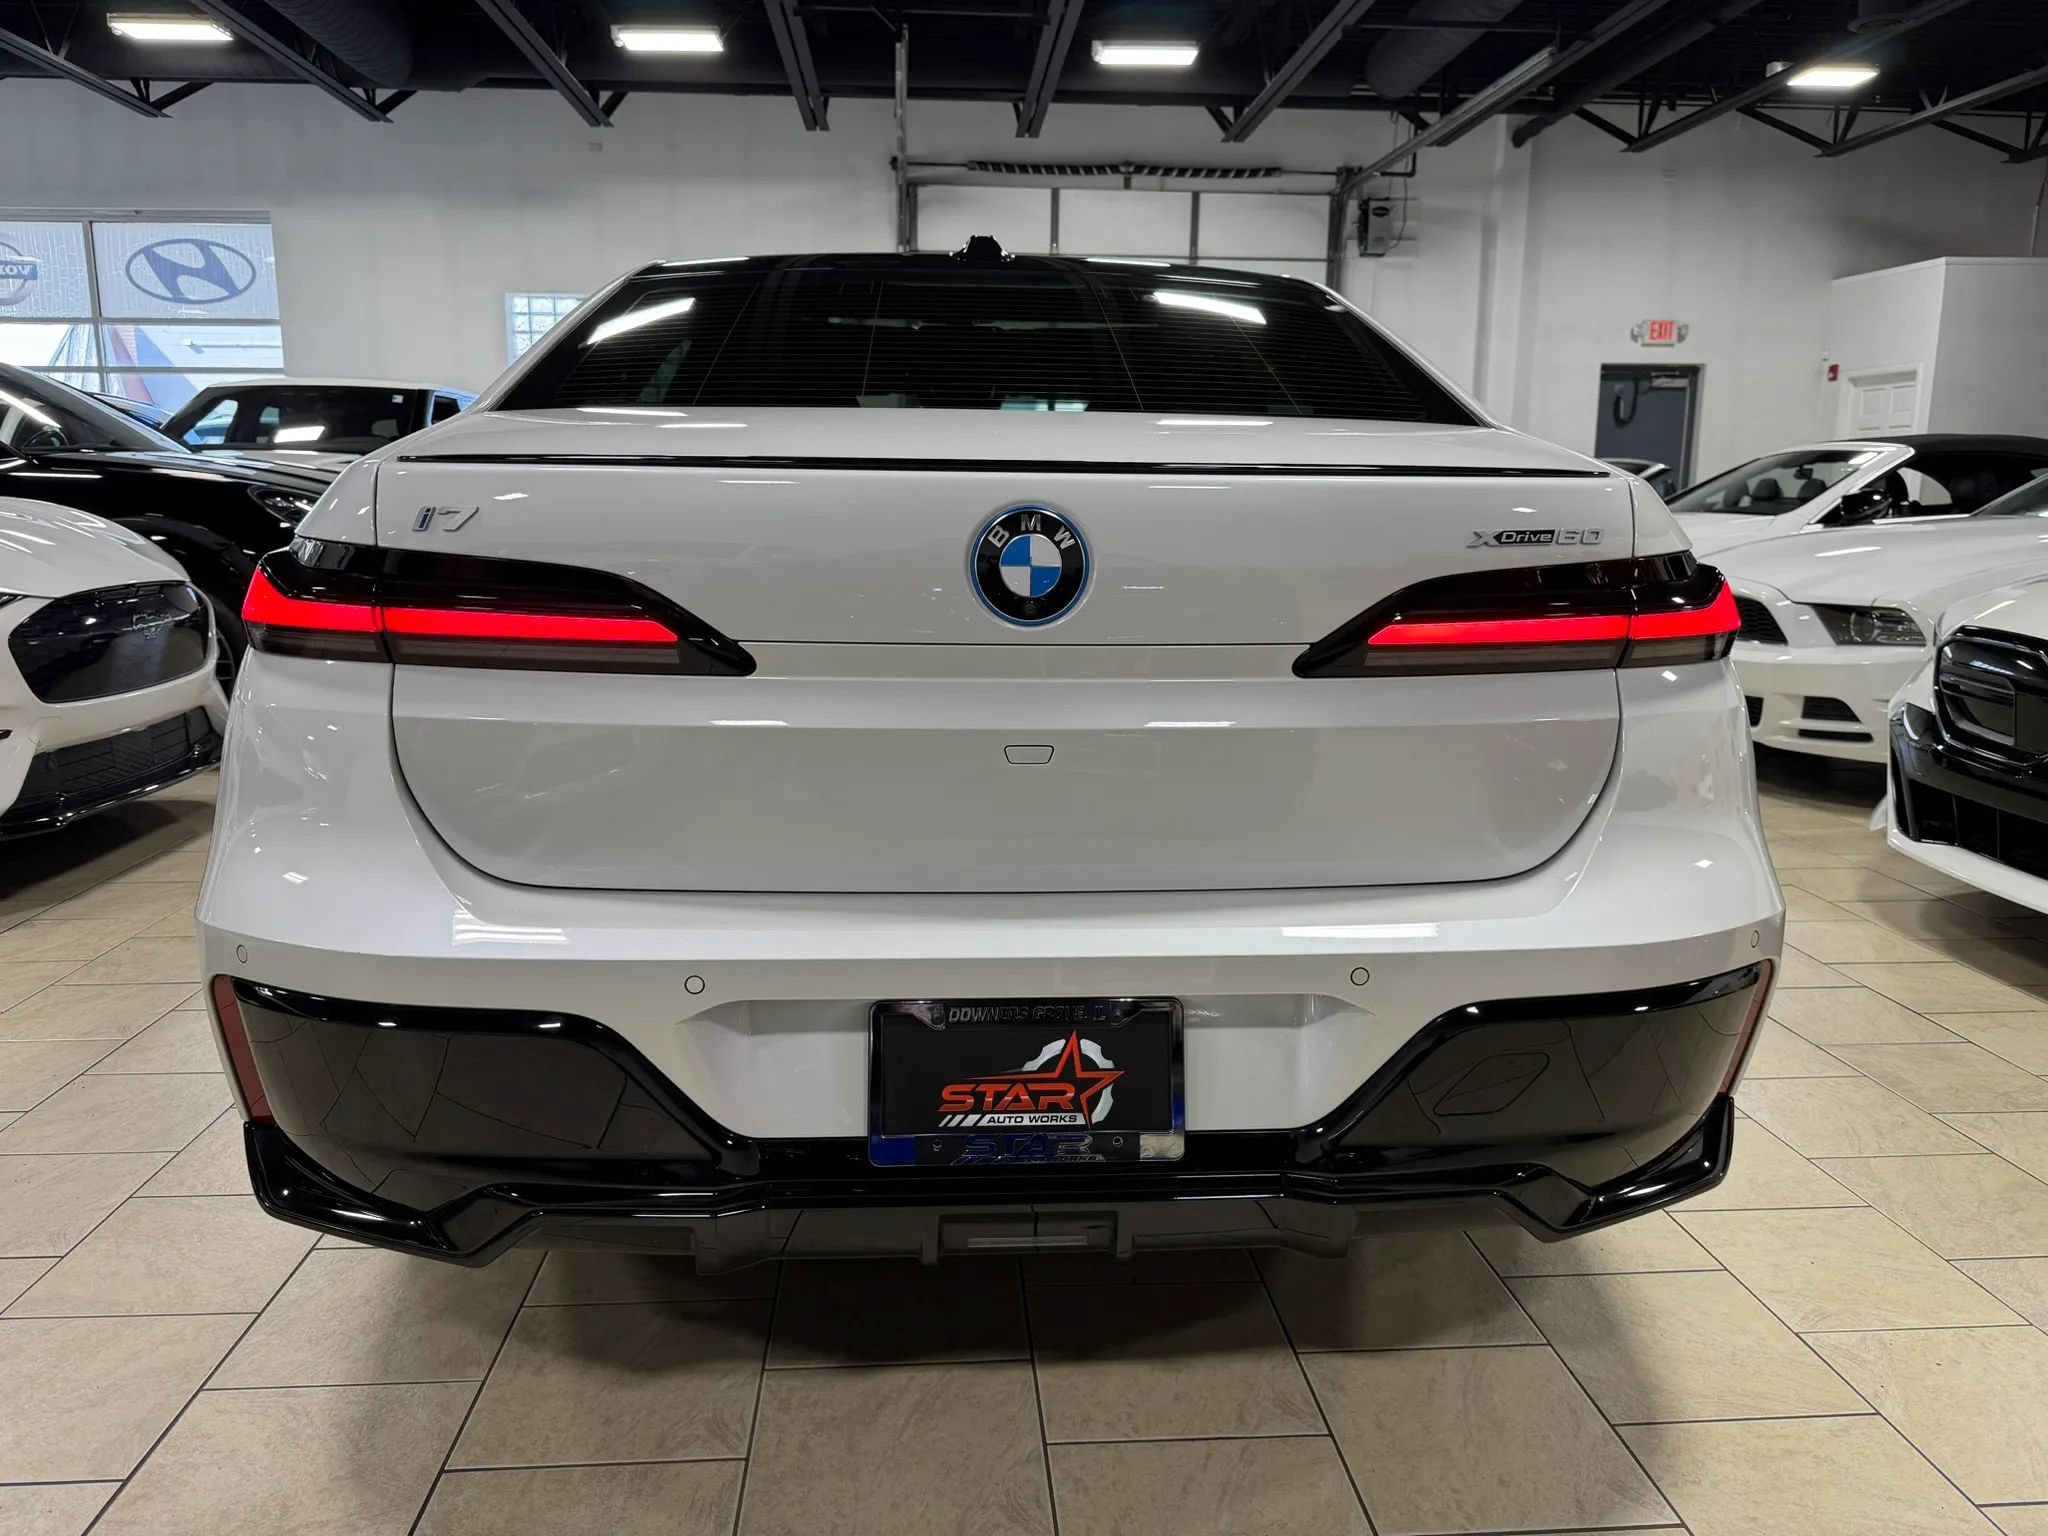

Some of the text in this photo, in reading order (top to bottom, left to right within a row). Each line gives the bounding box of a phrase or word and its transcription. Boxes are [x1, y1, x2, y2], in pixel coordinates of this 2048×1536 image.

[1650, 320, 1674, 341] EXIT
[411, 506, 479, 532] i7
[987, 514, 1076, 550] BMW
[938, 1082, 1075, 1112] STAR
[987, 1114, 1078, 1125] AUTO WORKS
